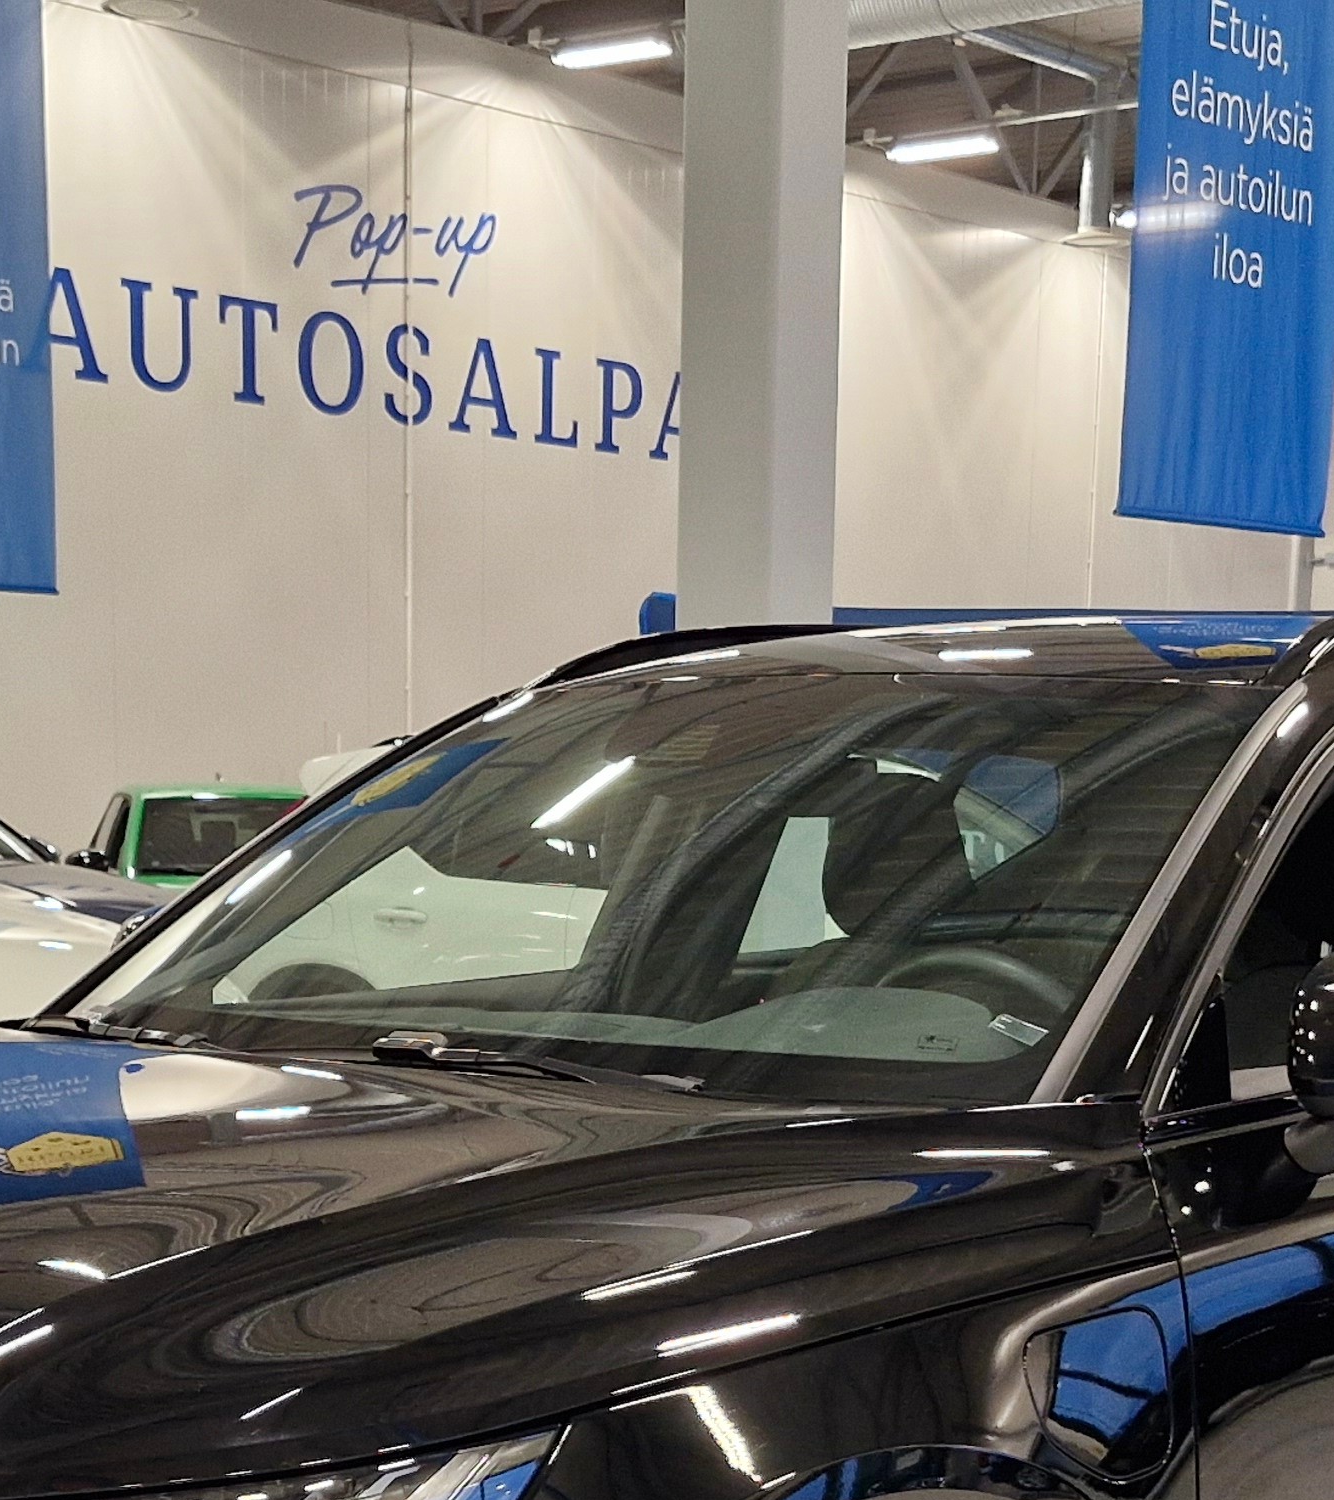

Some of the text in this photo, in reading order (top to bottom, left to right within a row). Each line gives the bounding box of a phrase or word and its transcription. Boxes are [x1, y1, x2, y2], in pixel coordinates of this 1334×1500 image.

[1209, 0, 1289, 76] Etuja,
[1171, 69, 1314, 152] elämyksiä
[1163, 142, 1313, 226] ja autoilun
[293, 184, 497, 298] Pop-up
[1212, 233, 1263, 289] iloa
